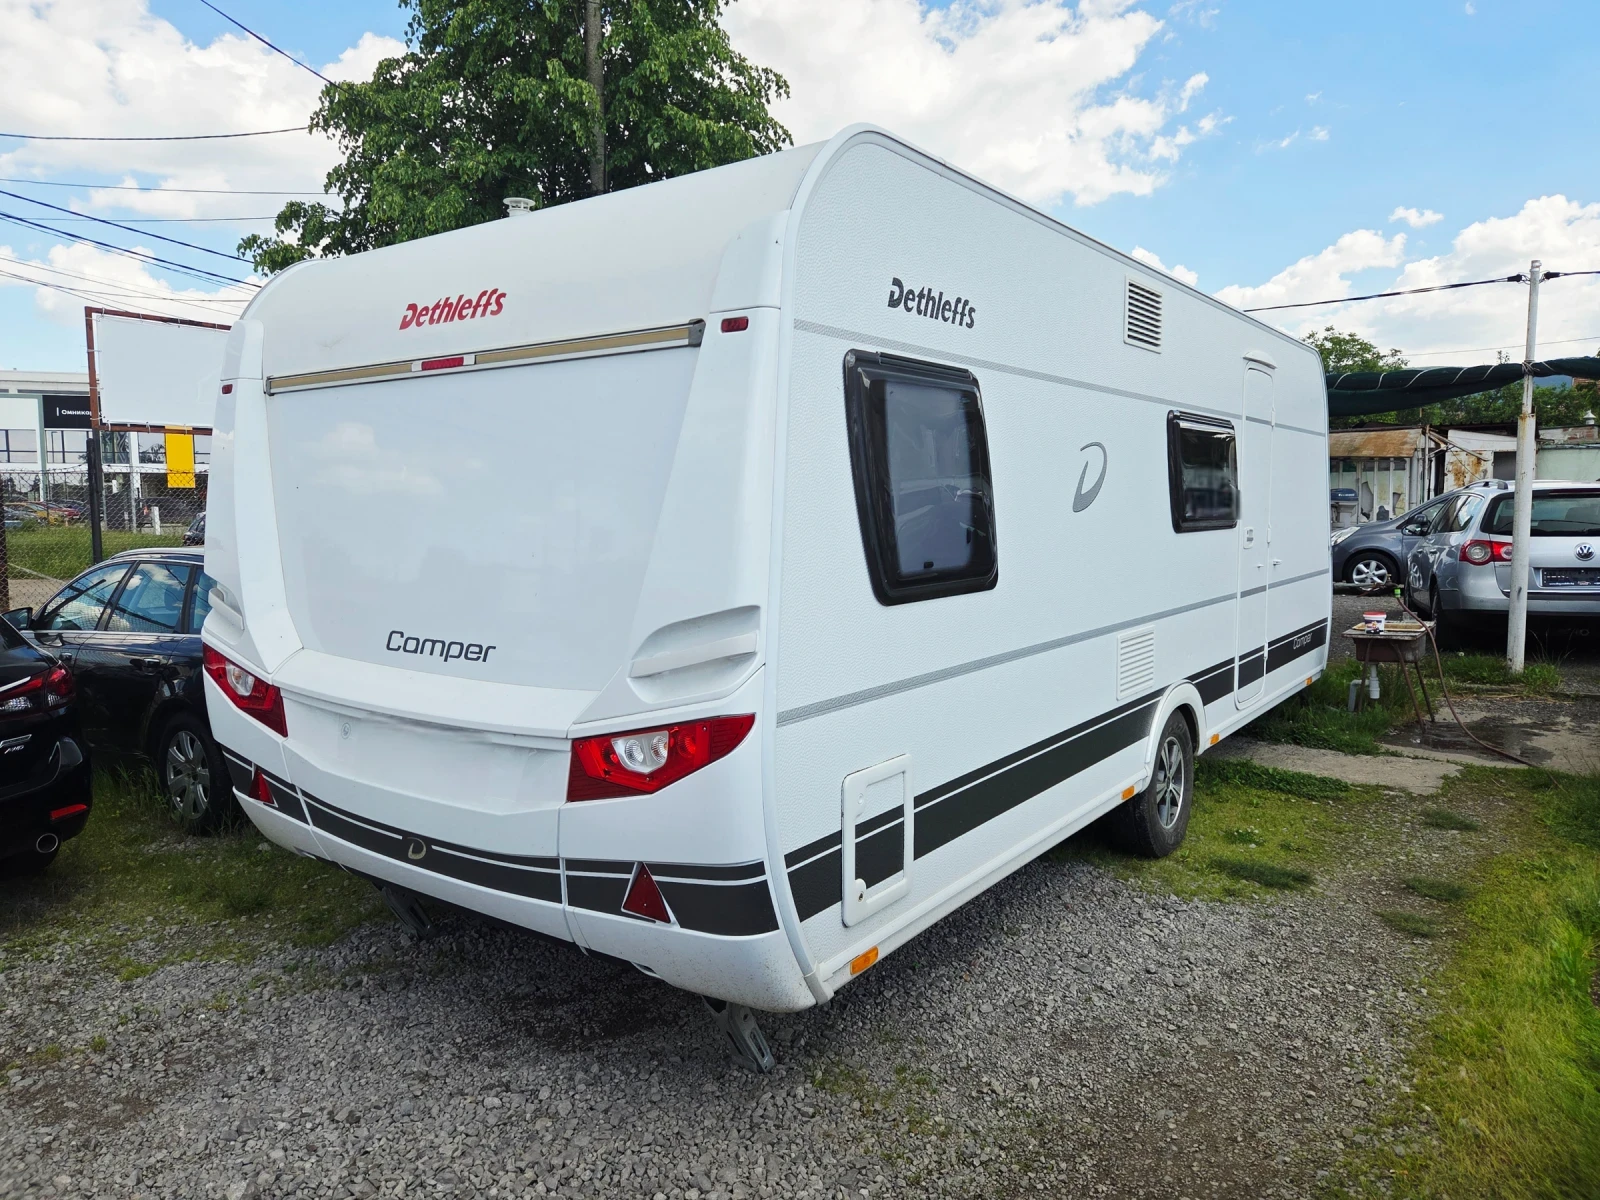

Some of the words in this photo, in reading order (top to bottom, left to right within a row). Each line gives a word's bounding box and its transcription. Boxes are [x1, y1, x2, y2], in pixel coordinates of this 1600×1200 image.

[399, 288, 507, 330] Dethleffs
[887, 277, 976, 329] Dethleffs
[386, 630, 497, 662] Camper
[1293, 632, 1313, 650] Camper
